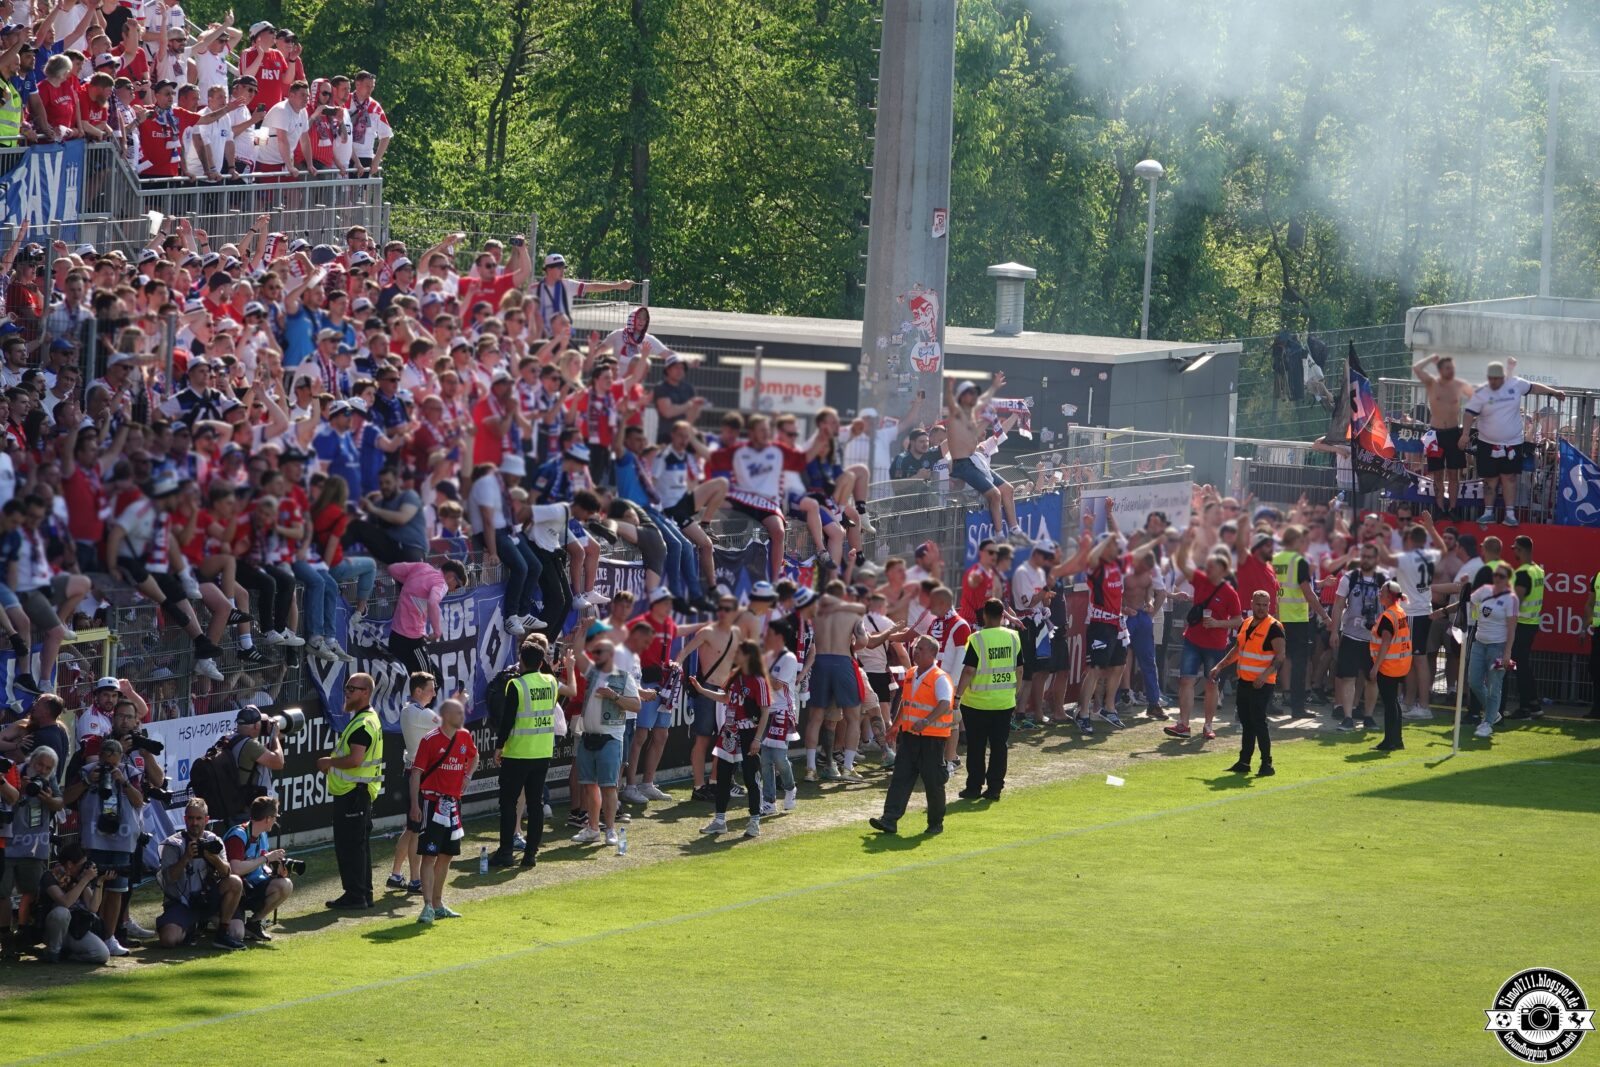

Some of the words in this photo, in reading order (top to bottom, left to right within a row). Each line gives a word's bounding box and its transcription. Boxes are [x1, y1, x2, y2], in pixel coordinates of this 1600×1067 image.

[261, 69, 281, 80] HSV
[743, 376, 823, 398] Pommes
[988, 646, 1013, 660] SECURITY
[992, 672, 1011, 683] 3259
[178, 719, 232, 741] HSV-POWER
[90, 820, 132, 837] FO
